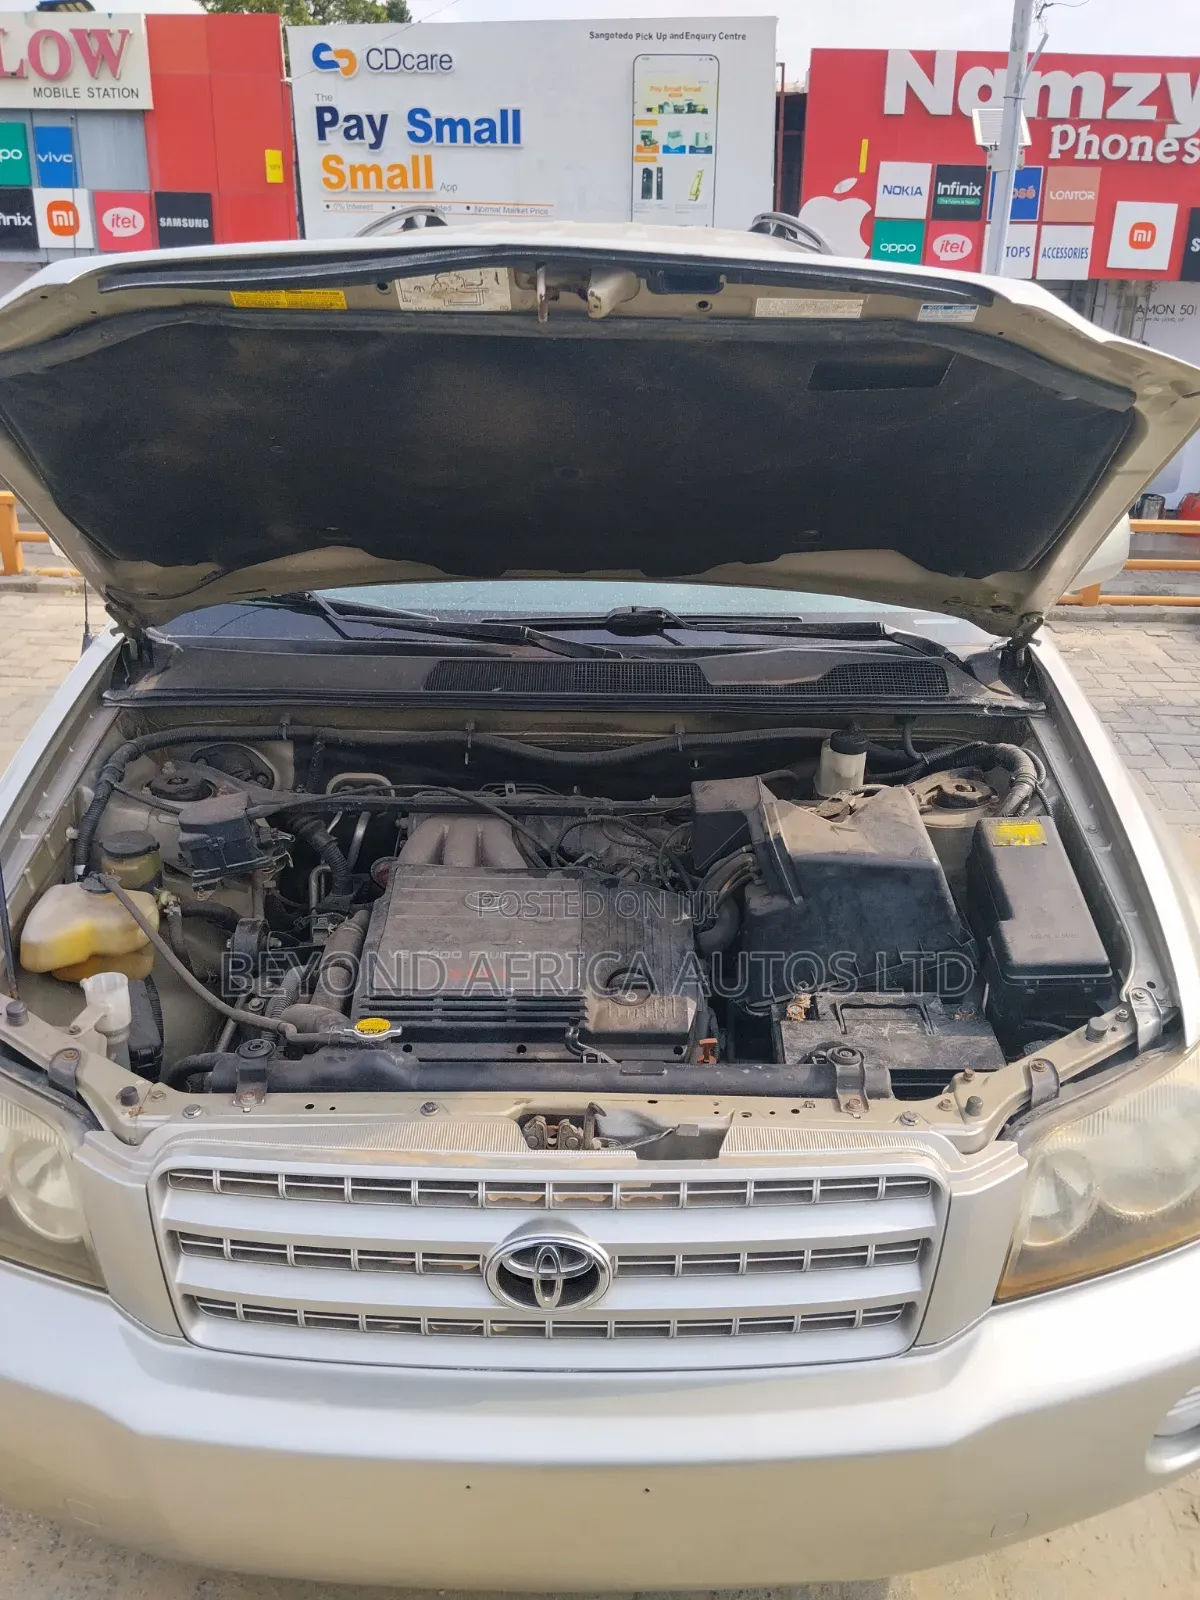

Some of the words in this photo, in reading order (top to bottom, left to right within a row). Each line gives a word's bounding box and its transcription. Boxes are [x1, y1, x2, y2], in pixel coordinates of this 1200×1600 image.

[589, 31, 633, 40] Sangotedo
[635, 32, 653, 40] Pick
[656, 32, 667, 41] Up
[669, 32, 684, 40] and
[685, 32, 716, 41] Enquiry
[719, 32, 746, 40] Centre
[366, 48, 453, 70] CDcare
[33, 87, 81, 98] MOBILE
[88, 87, 139, 98] STATION
[315, 93, 333, 102] The
[315, 106, 388, 149] Pay
[407, 108, 521, 144] Small
[1048, 123, 1200, 163] Phones
[37, 152, 73, 162] vivo
[322, 154, 433, 189] Small
[440, 182, 458, 192] App
[882, 184, 923, 196] NOKIA
[937, 181, 982, 196] Infinix
[1050, 190, 1095, 200] LONTOR
[474, 205, 501, 213] Normal
[503, 207, 527, 215] Market
[530, 207, 548, 215] Price
[111, 213, 136, 228] itel
[159, 217, 209, 228] SAMSUNG
[880, 243, 916, 253] oppo
[940, 240, 965, 253] itel
[1041, 247, 1088, 259] ACCESSORIES
